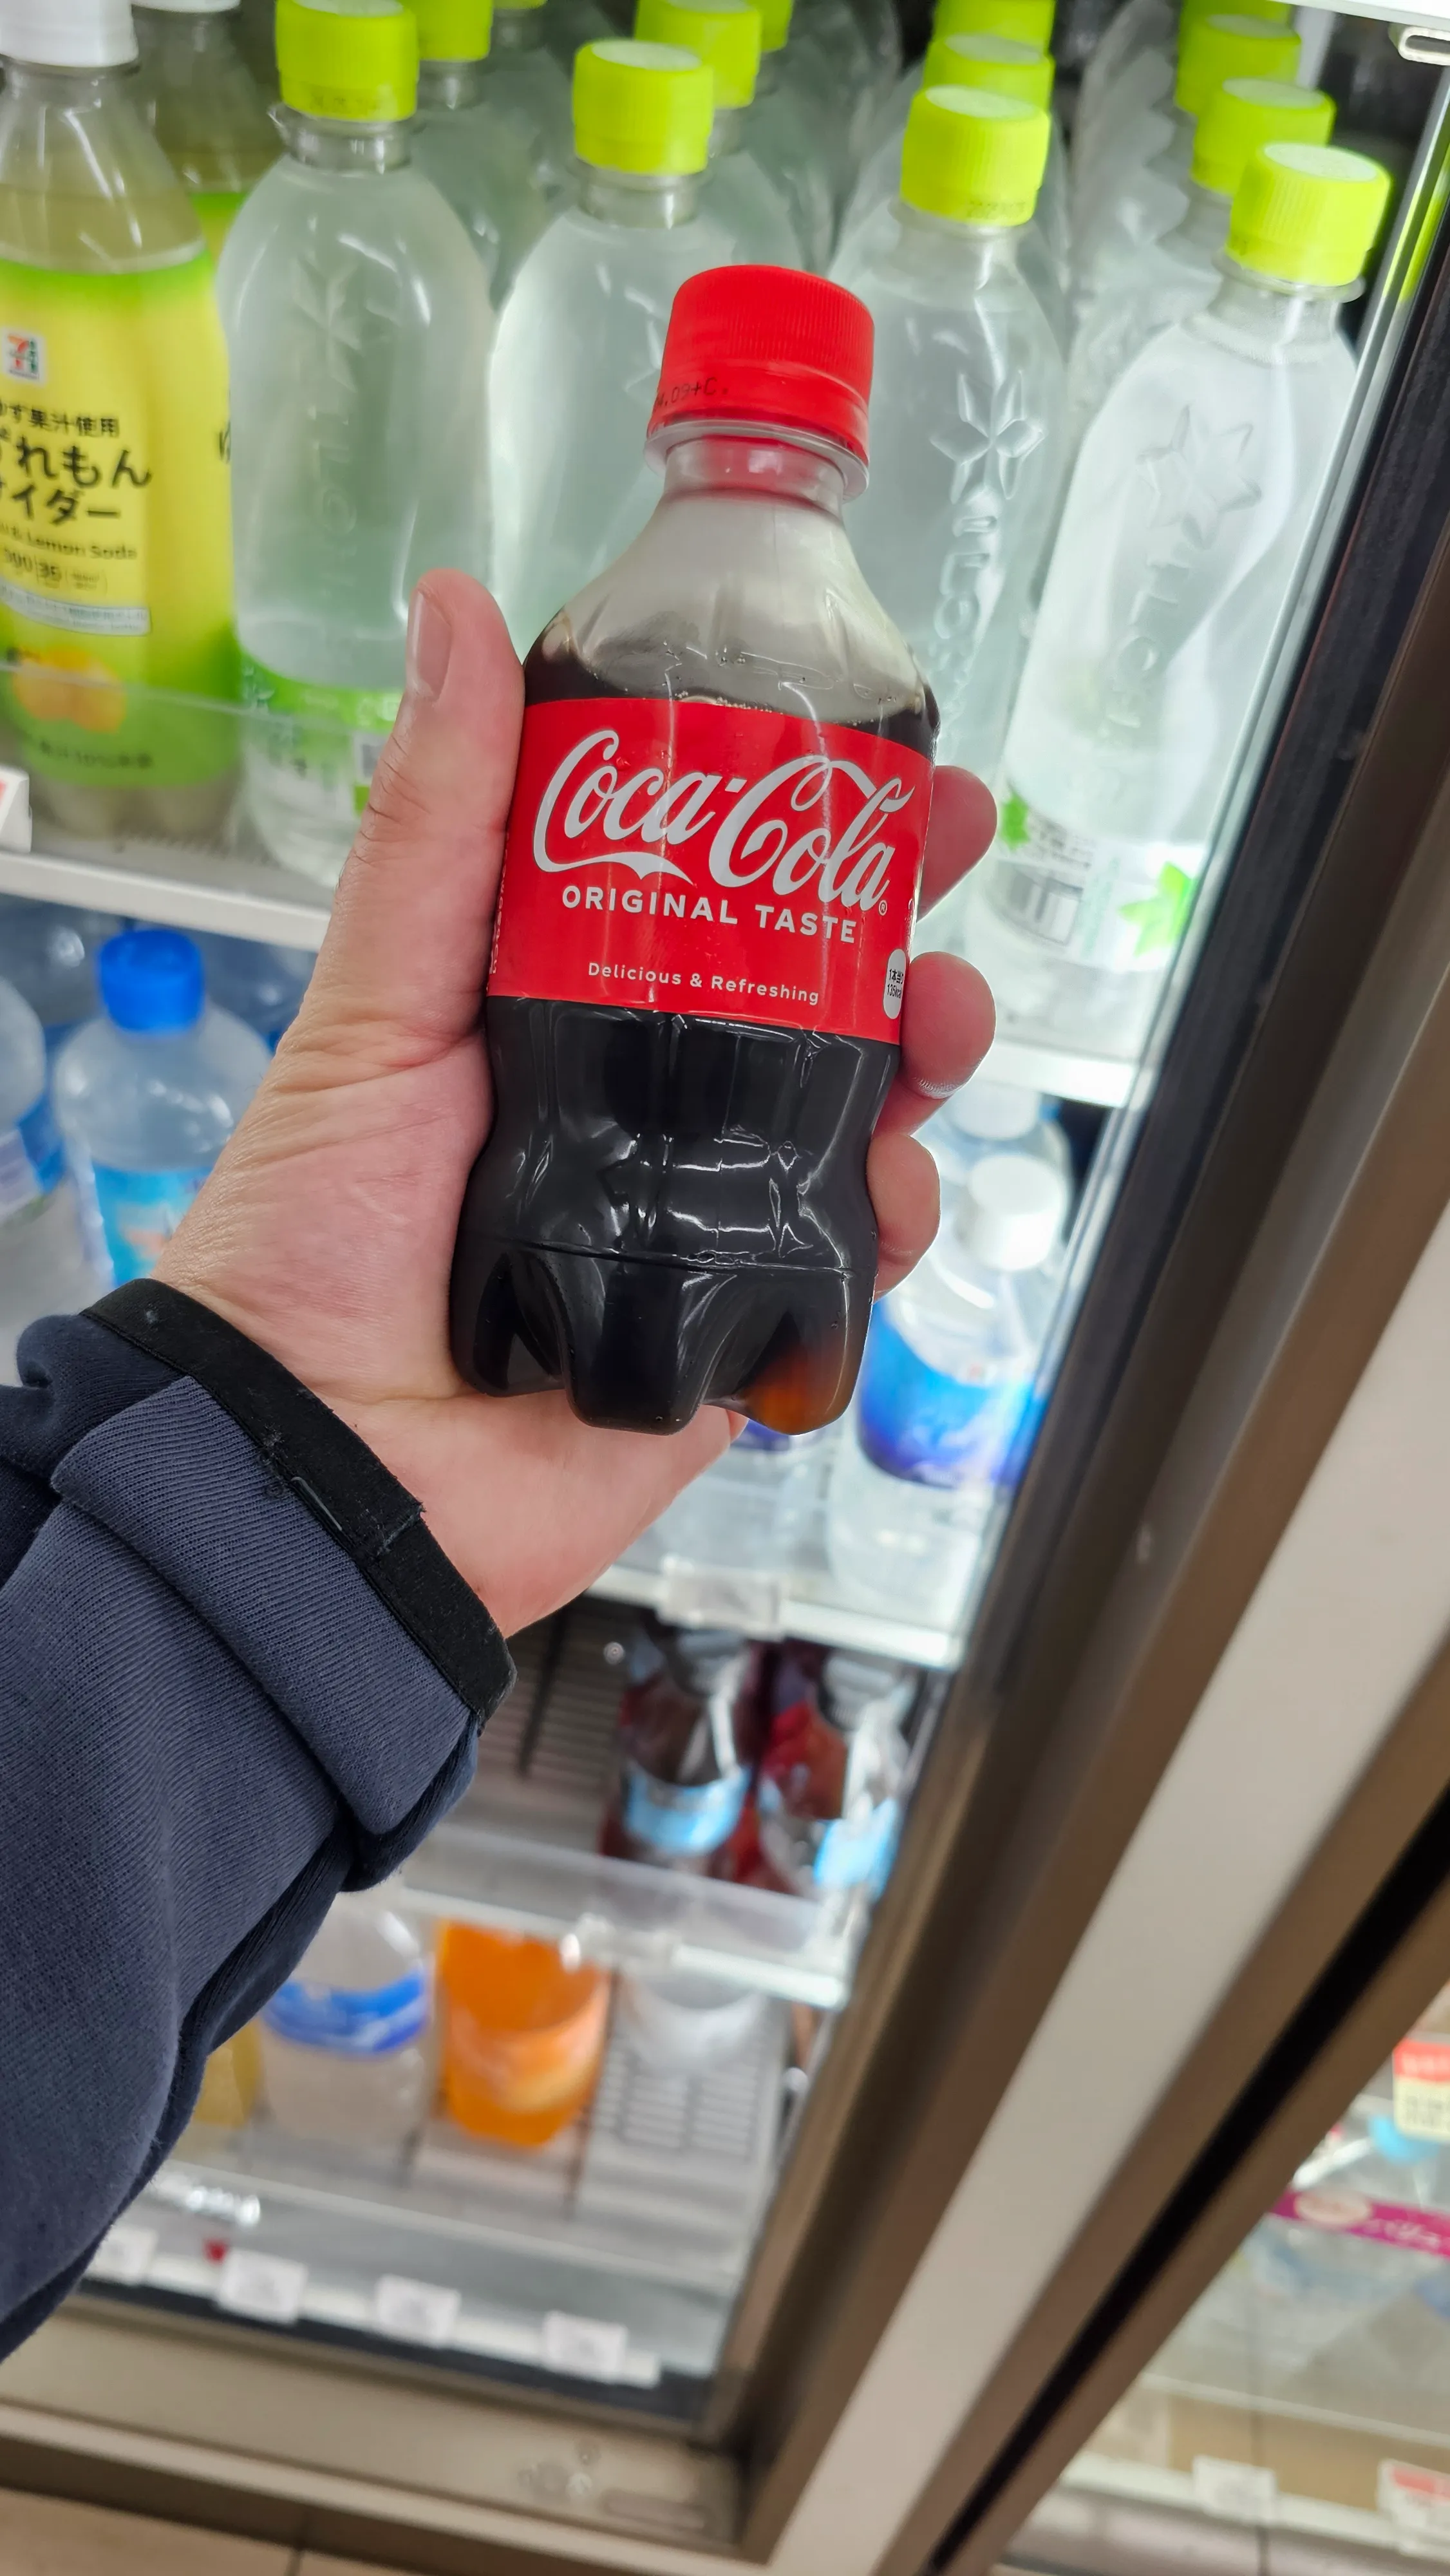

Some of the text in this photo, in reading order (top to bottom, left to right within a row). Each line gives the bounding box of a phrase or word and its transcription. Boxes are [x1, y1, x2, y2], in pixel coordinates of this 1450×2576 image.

[0, 435, 152, 488] れもん
[533, 730, 915, 911] Coca-Cola
[562, 885, 858, 944] ORIGINAL TASTE
[588, 962, 820, 1006] Delicious & Refreshing
